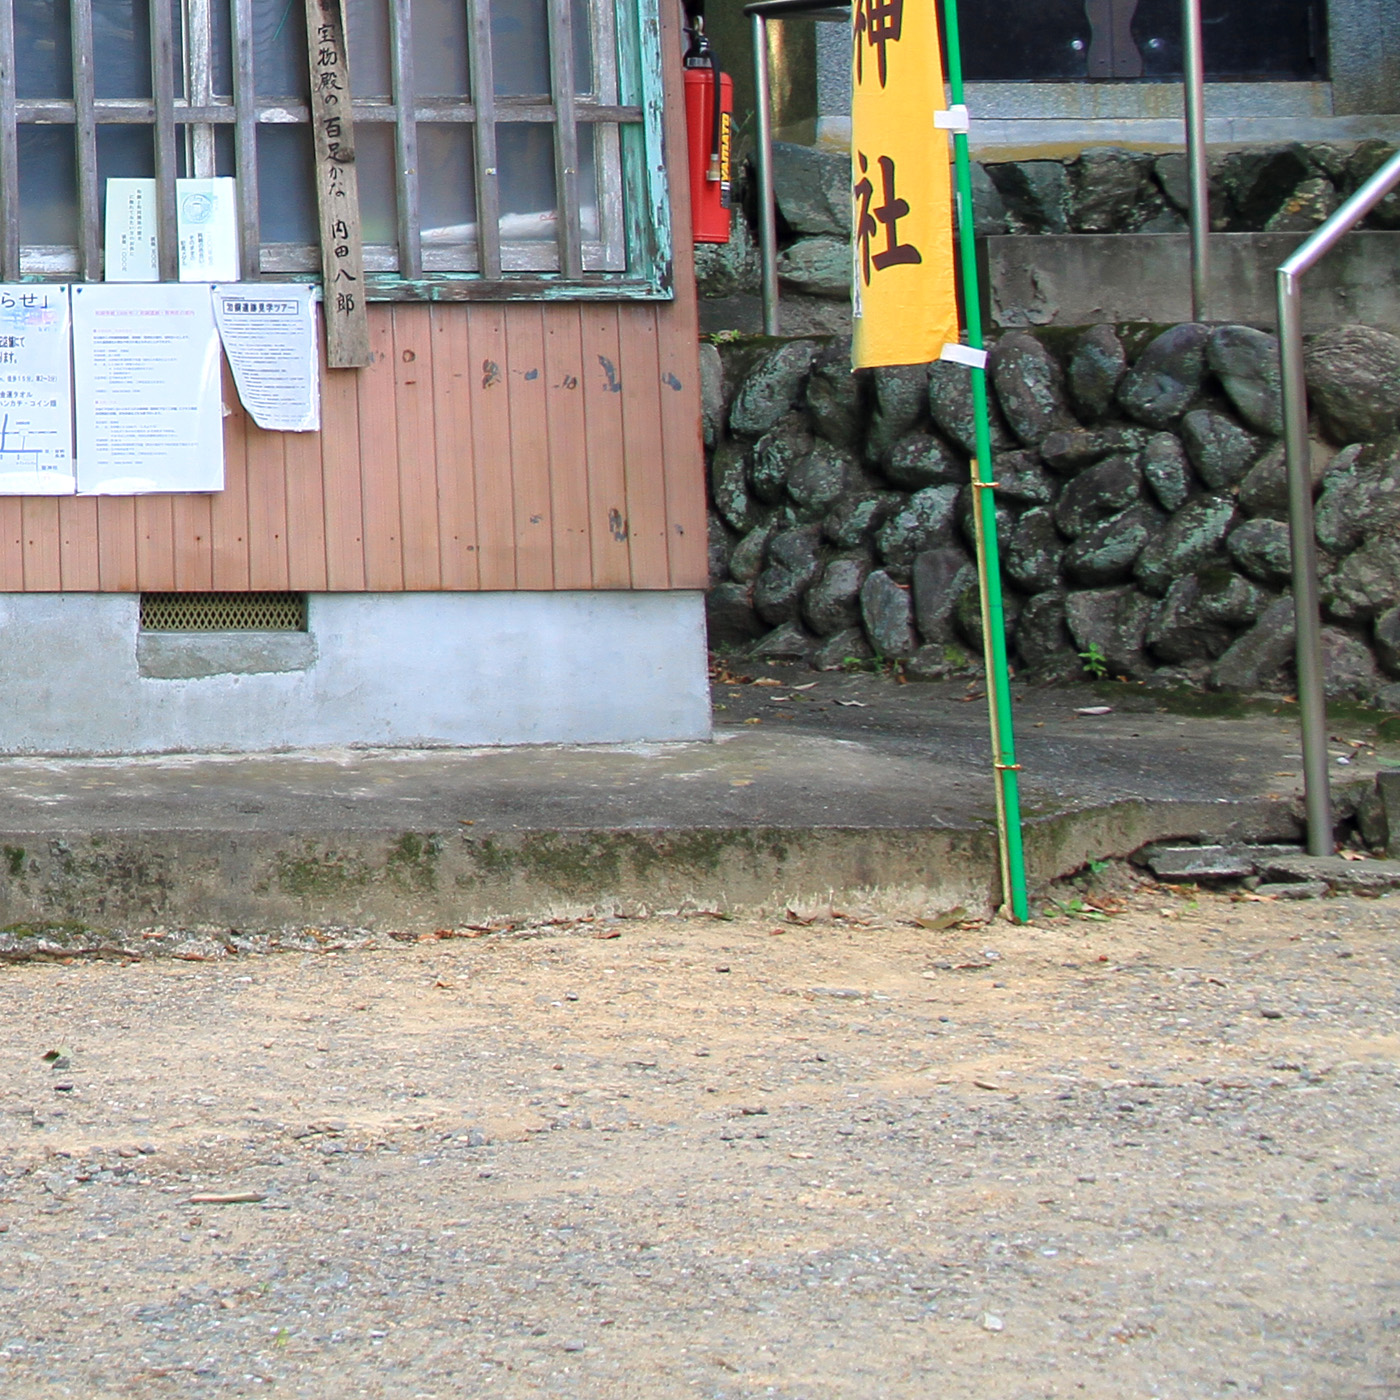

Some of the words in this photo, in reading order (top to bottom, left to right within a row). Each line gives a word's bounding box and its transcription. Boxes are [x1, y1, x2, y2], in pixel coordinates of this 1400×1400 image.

[720, 112, 731, 181] YAMATO
[330, 219, 357, 318] 内田八郎
